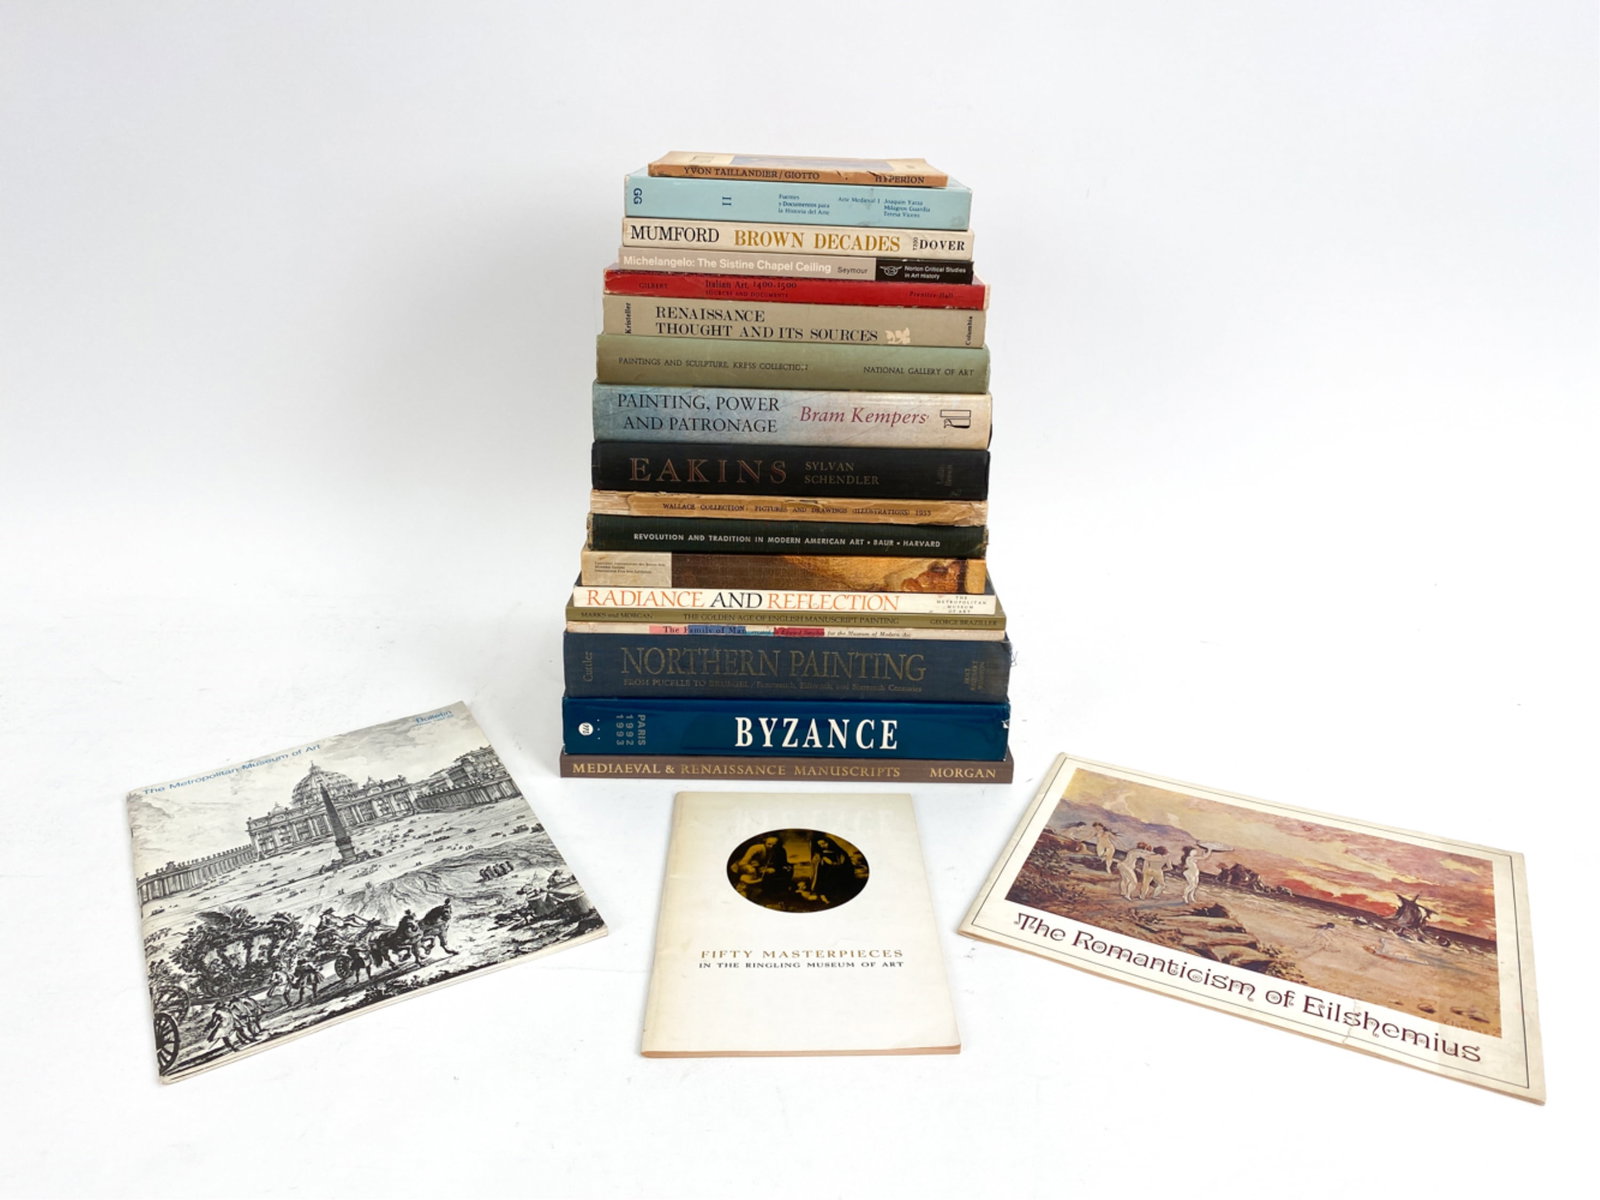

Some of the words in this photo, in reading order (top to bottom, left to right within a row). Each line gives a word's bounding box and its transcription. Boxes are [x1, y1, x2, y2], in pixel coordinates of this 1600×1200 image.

[684, 166, 711, 175] YVON
[715, 168, 778, 178] TAILLANDIER
[784, 171, 820, 180] GIOTTO
[630, 224, 720, 243] MUMFORD
[734, 229, 805, 248] BROWN
[814, 232, 901, 252] DECADES
[919, 239, 966, 251] DOVER
[623, 255, 696, 268] Michelangelo:
[697, 258, 717, 268] The
[719, 258, 754, 270] Sistine
[756, 259, 794, 272] Chapel
[795, 261, 832, 273] Ceiling
[837, 266, 868, 276] Seymour
[945, 266, 967, 274] Studies
[705, 279, 731, 289] Italian
[920, 273, 940, 281] History
[624, 302, 632, 335] Kristeller
[655, 306, 765, 322] RENAISSANCE
[655, 322, 733, 337] THOUGHT
[739, 325, 774, 339] AND
[778, 327, 804, 340] ITS
[809, 328, 878, 342] SOURCES
[965, 315, 973, 346] Columbia
[618, 357, 661, 366] PAINTINGS
[664, 358, 682, 367] AND
[863, 366, 904, 375] NATIONAL
[908, 367, 942, 376] GALLERY
[944, 368, 956, 376] OF
[958, 369, 975, 377] ART
[617, 393, 711, 412] PAINTING,
[716, 396, 780, 412] POWER
[623, 416, 663, 431] AND
[669, 417, 778, 433] PATRONAGE
[800, 405, 845, 422] Bram
[850, 407, 927, 428] Kempers
[629, 457, 788, 485] EAKINS
[804, 460, 855, 472] SYLVAN
[804, 474, 880, 486] SCHENDLER
[662, 502, 696, 511] WALLACE
[633, 532, 684, 541] REVOLUTION
[687, 534, 706, 542] AND
[708, 534, 752, 543] TRADITION
[767, 536, 801, 544] MODERN
[804, 537, 846, 545] AMERICAN
[849, 538, 864, 546] ART
[873, 539, 894, 547] BAUR
[902, 540, 941, 548] HARVARD
[586, 589, 705, 608] RADIANCE
[709, 591, 763, 609] AND
[767, 593, 900, 612] REFLECTION
[683, 613, 699, 621] THE
[700, 613, 736, 622] GOLDEN
[755, 614, 767, 622] OF
[768, 614, 806, 623] ENGLISH
[806, 615, 858, 624] MANUSCRIPT
[859, 616, 899, 625] PAINTING
[663, 625, 680, 633] The
[716, 626, 726, 634] of
[848, 630, 870, 638] Museum
[621, 647, 782, 677] NORTHERN
[789, 649, 927, 682] PAINTING
[615, 714, 625, 746] 1993
[625, 714, 634, 746] 1992
[637, 714, 646, 746] PARIS
[734, 716, 898, 750] BYZANCE
[143, 785, 166, 796] The
[168, 766, 240, 790] Metropolitan
[241, 753, 289, 770] Museum
[291, 748, 303, 757] of
[305, 743, 321, 753] Art
[572, 762, 661, 775] MEDIAEVAL
[665, 763, 676, 775] &
[681, 764, 787, 776] RENAISSANCE
[793, 765, 901, 778] MANUSCRIPTS
[929, 767, 996, 779] MORGAN
[701, 950, 752, 958] FIFTY
[762, 949, 903, 958] MASTERPIECES
[1014, 912, 1067, 942] The
[1072, 929, 1257, 1002] Romanticism
[1265, 988, 1296, 1008] of
[1302, 994, 1481, 1063] Eilshemius
